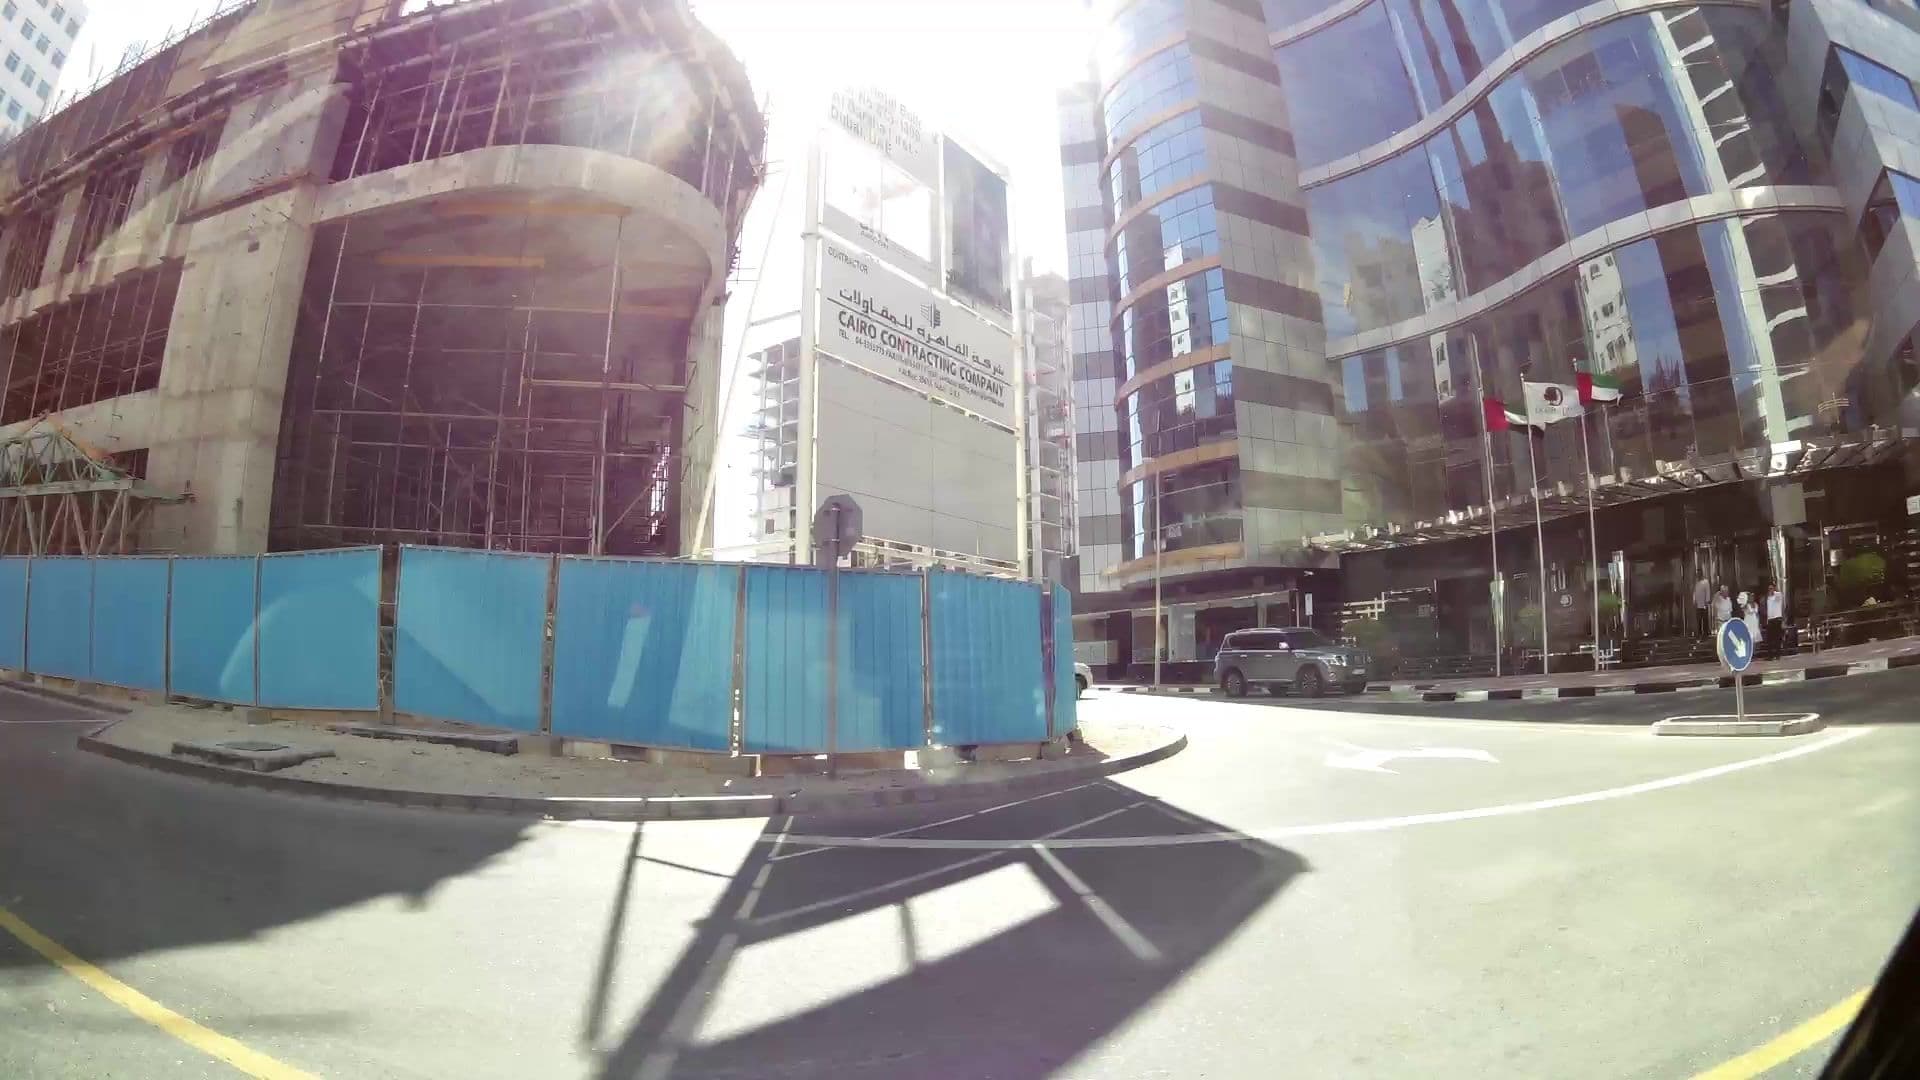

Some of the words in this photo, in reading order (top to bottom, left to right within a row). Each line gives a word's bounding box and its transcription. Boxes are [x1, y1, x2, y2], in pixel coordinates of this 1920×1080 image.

[828, 246, 868, 274] CONTRACTOR
[839, 288, 913, 331] للمقاولات
[838, 310, 877, 339] CAIRO
[880, 329, 956, 377] CONTRACTING
[959, 365, 1004, 397] COMPANY
